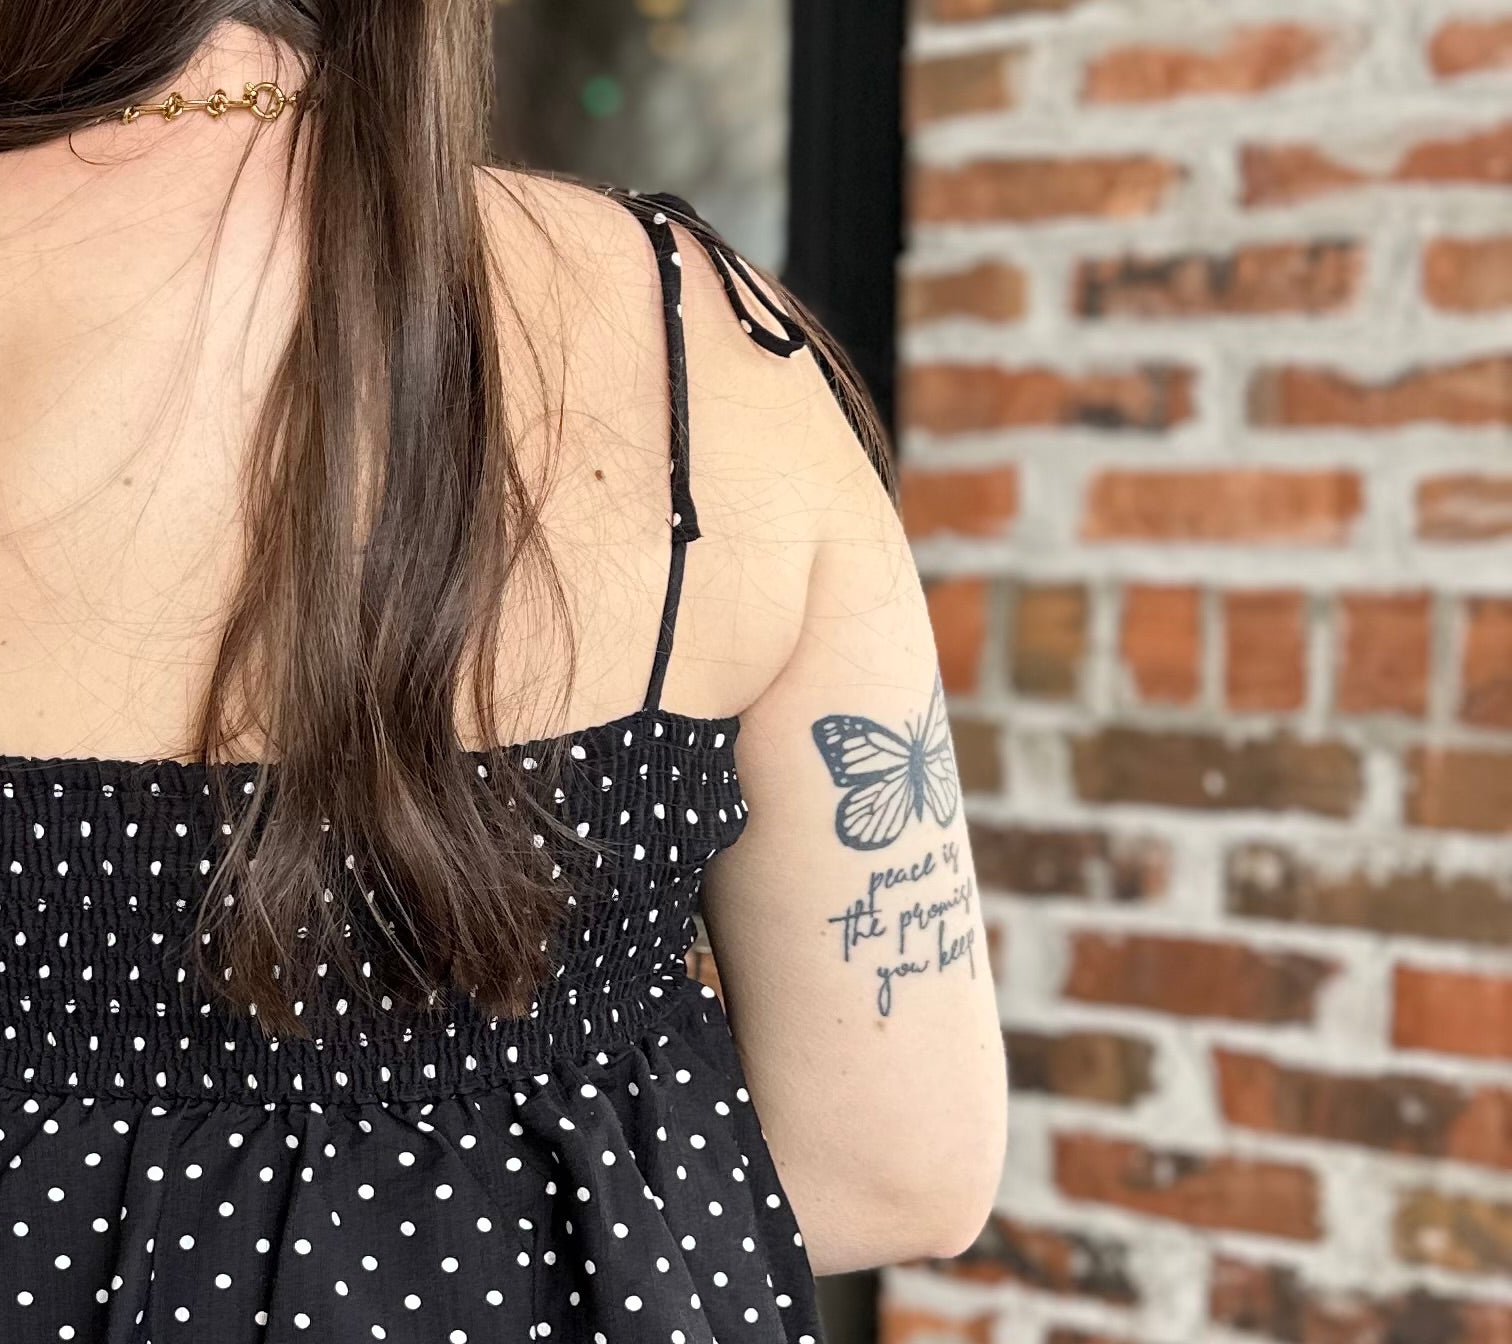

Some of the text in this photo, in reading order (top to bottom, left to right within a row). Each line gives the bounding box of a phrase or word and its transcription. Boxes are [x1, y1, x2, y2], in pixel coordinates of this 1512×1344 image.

[867, 841, 960, 918] peace is
[828, 899, 886, 963] the
[876, 919, 976, 1017] you keep
